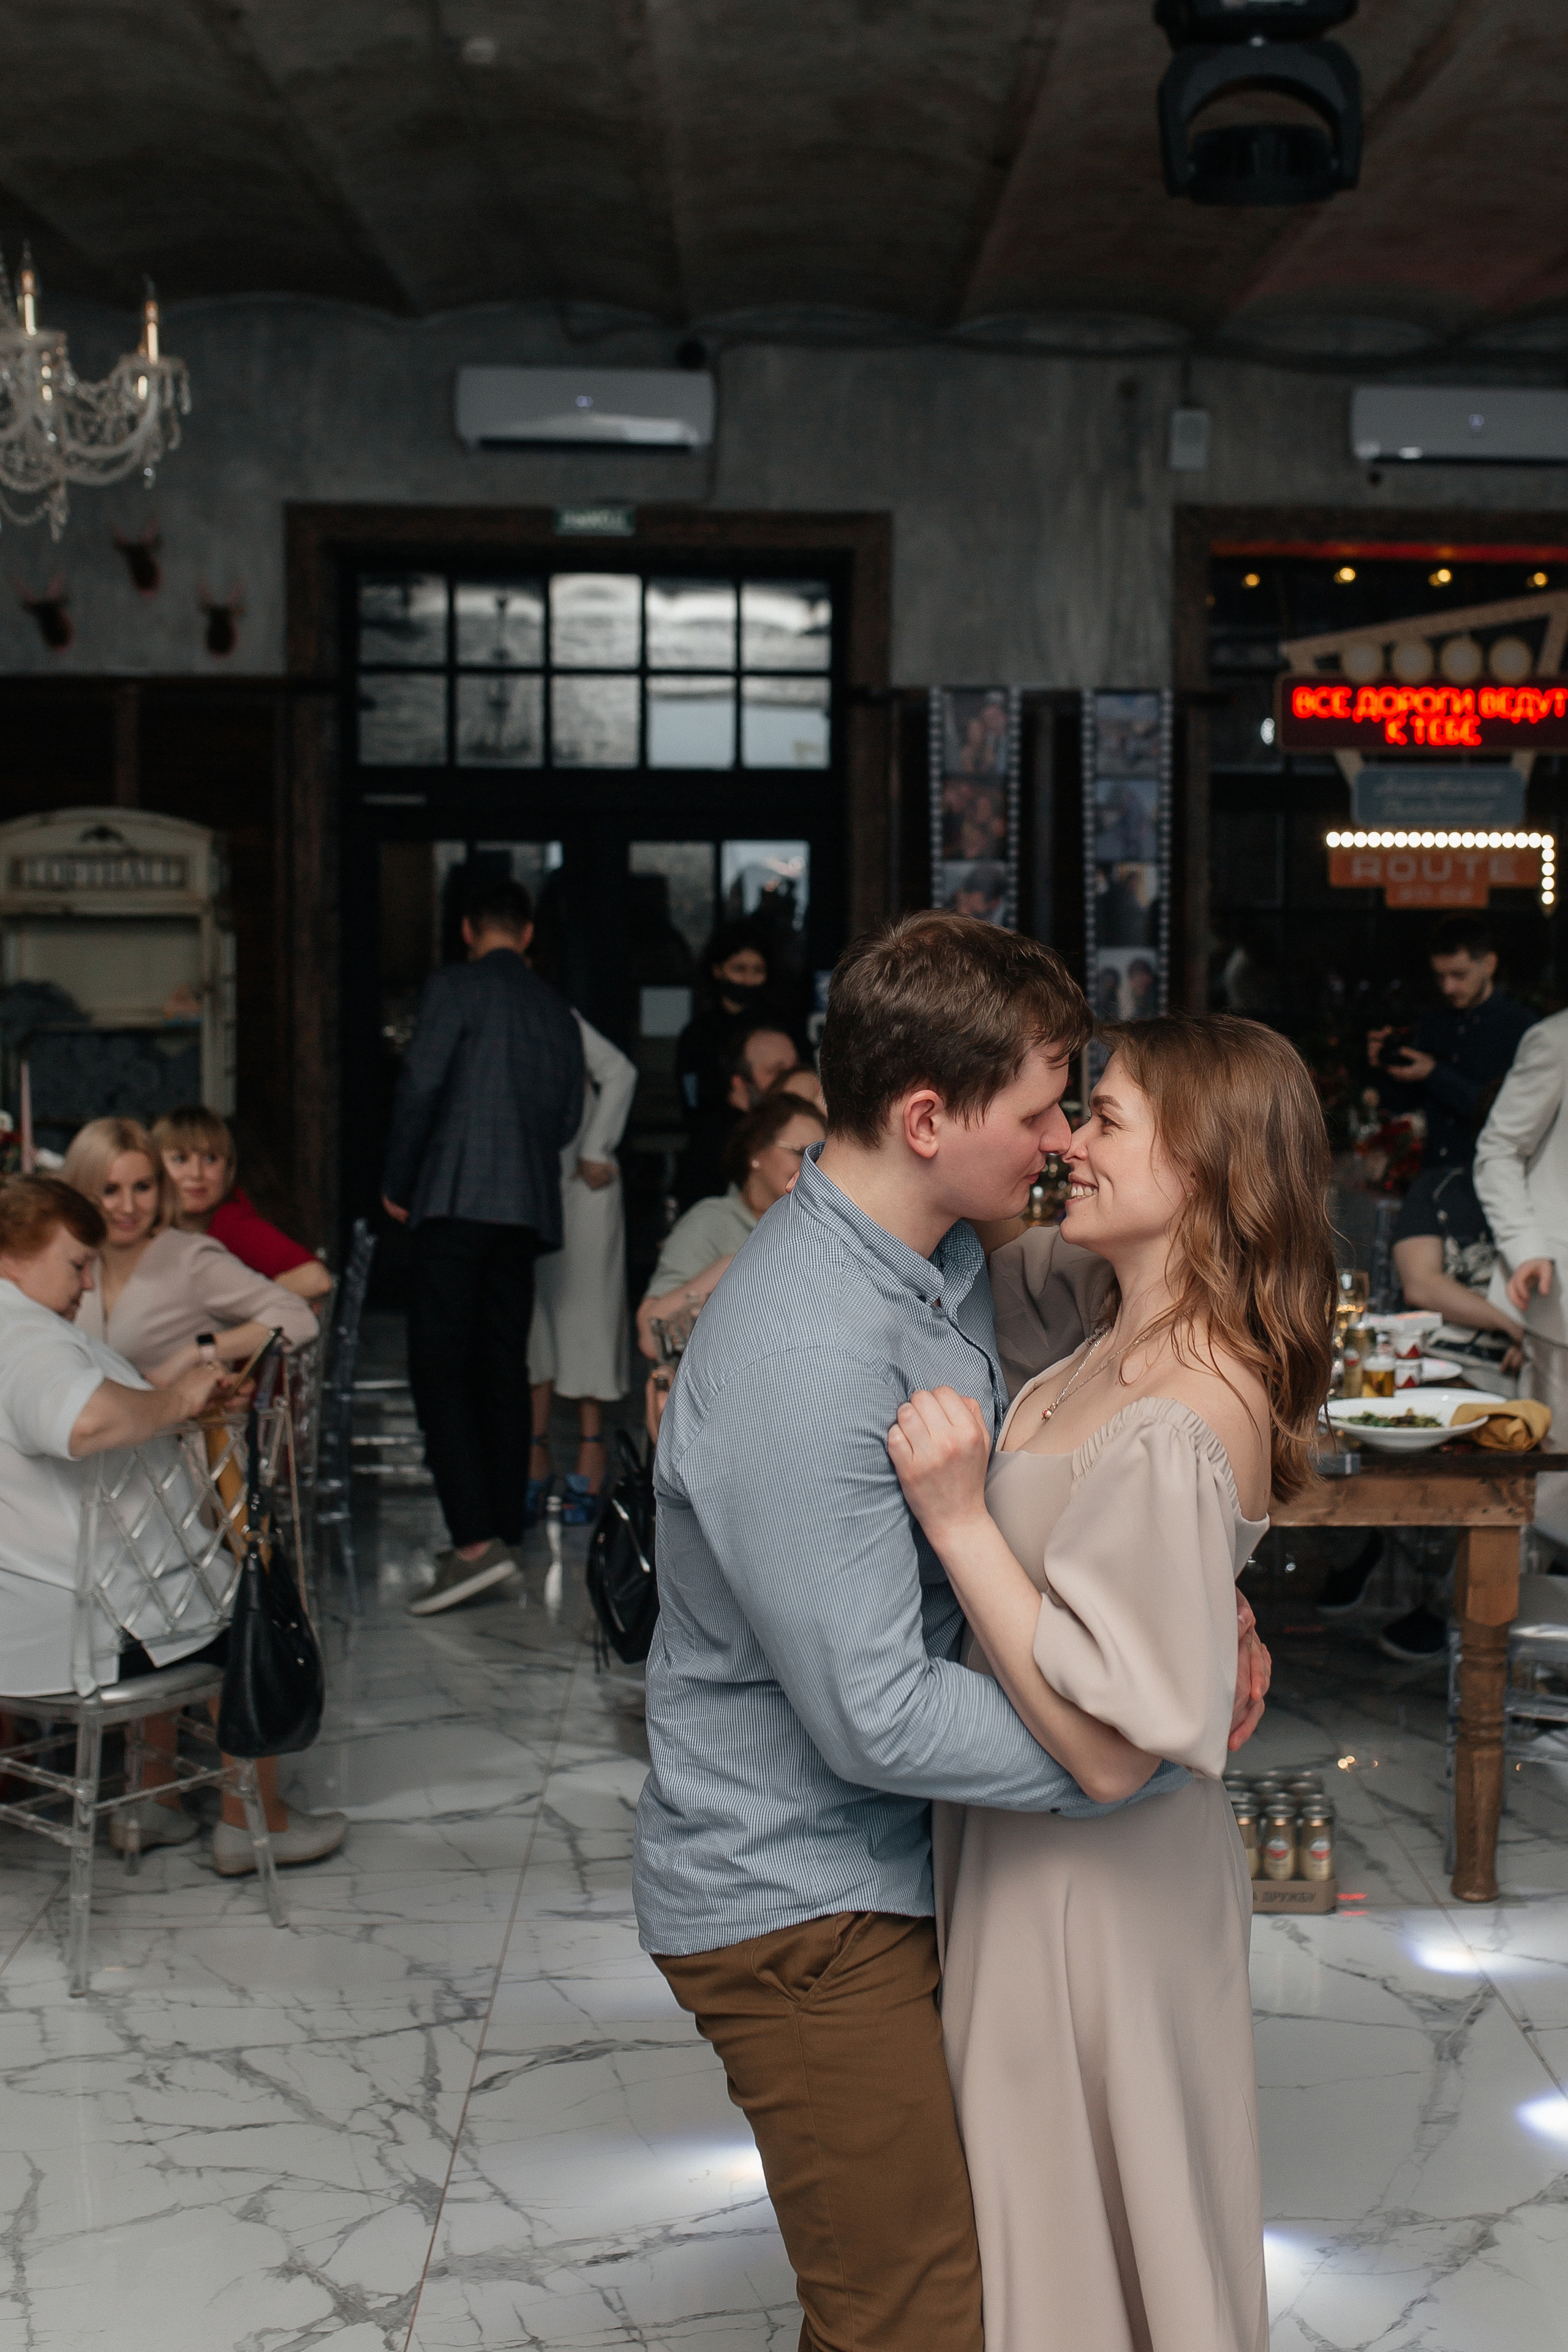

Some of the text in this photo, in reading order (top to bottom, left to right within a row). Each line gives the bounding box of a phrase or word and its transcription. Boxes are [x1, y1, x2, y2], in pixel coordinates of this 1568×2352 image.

[1292, 687, 1568, 723] ВСЕ ДОРОГИ ВЕДУТ
[1385, 715, 1482, 746] К ТЕБЕ
[1351, 854, 1517, 882] ROUTE
